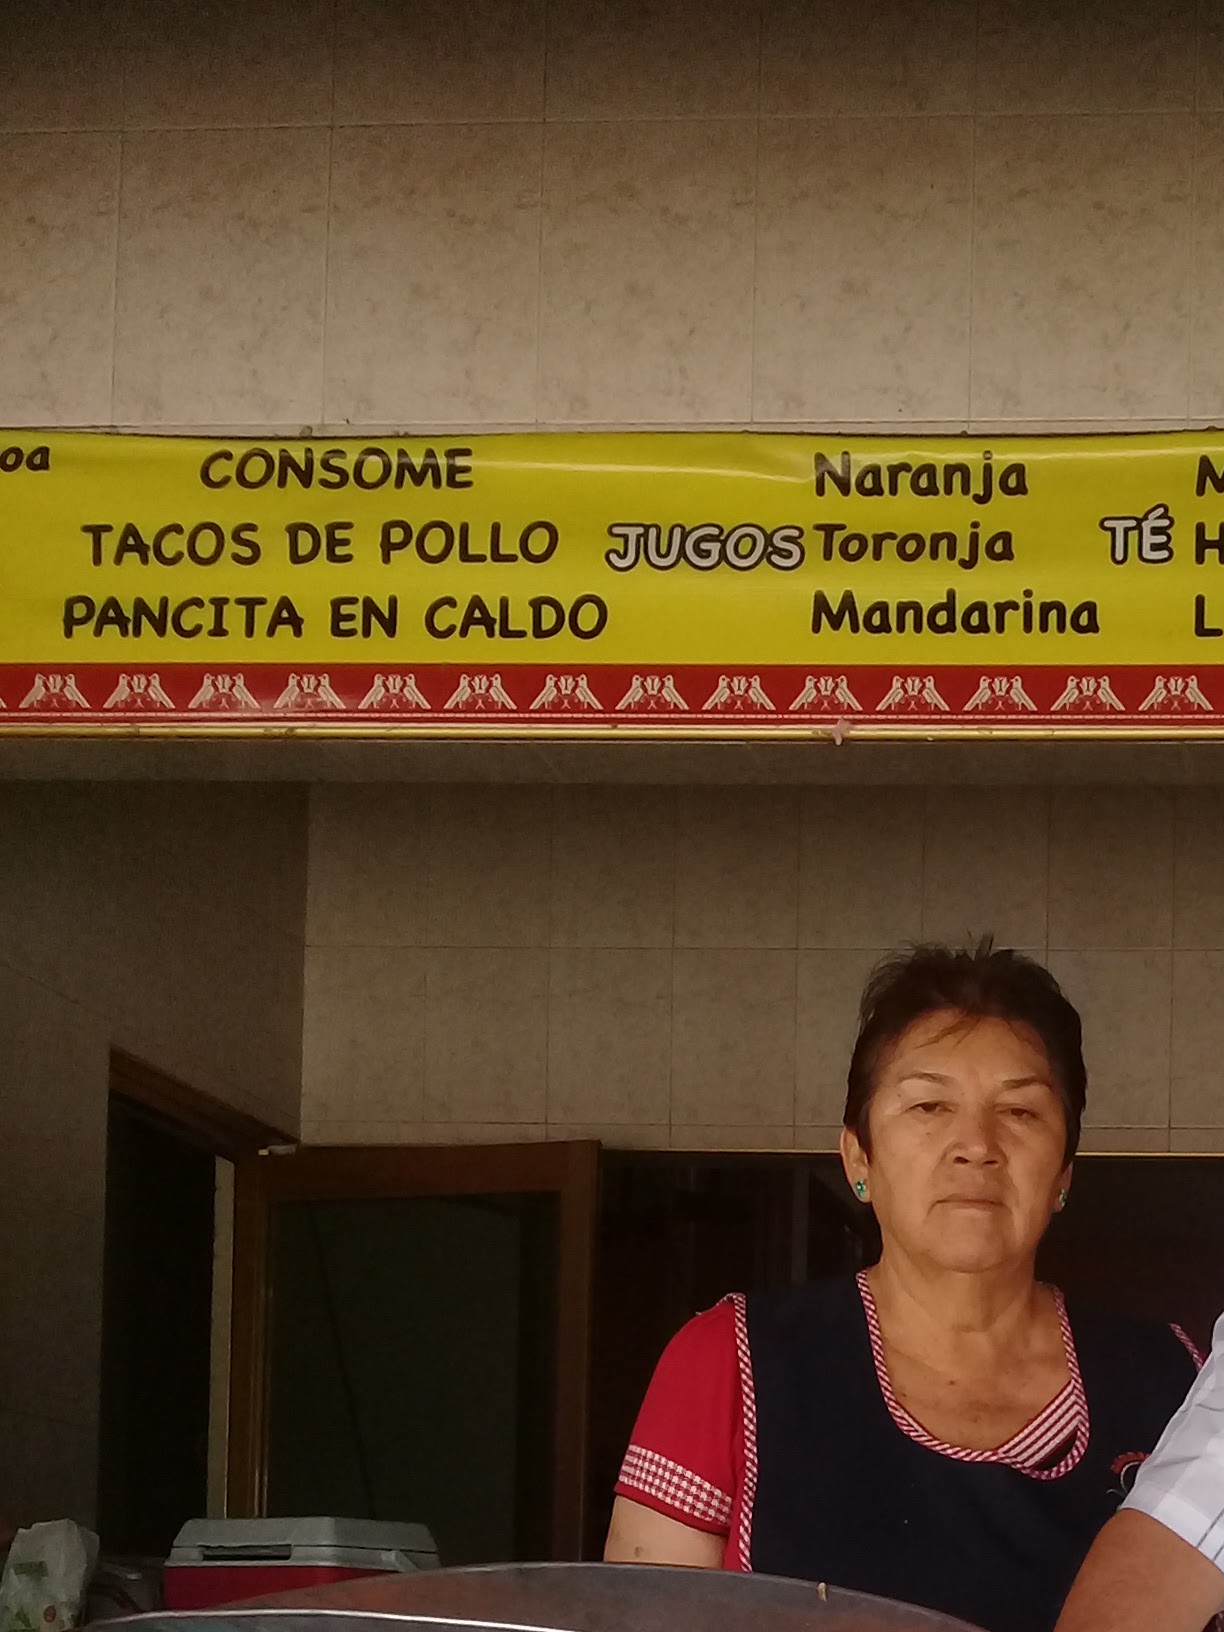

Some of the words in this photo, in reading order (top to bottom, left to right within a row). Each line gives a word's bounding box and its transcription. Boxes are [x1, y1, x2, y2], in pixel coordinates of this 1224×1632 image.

[200, 447, 474, 490] CONSOME
[813, 450, 1029, 505] Naranja
[81, 521, 261, 566] TACOS
[286, 521, 354, 565] DE
[380, 519, 559, 565] POLLO
[604, 522, 806, 572] JUGOS
[812, 521, 1015, 570] Toronja
[1098, 503, 1175, 565] TÉ
[62, 595, 305, 639] PANCITA
[330, 595, 398, 639] EN
[424, 594, 608, 640] CALDO
[811, 589, 1100, 635] Mandarina
